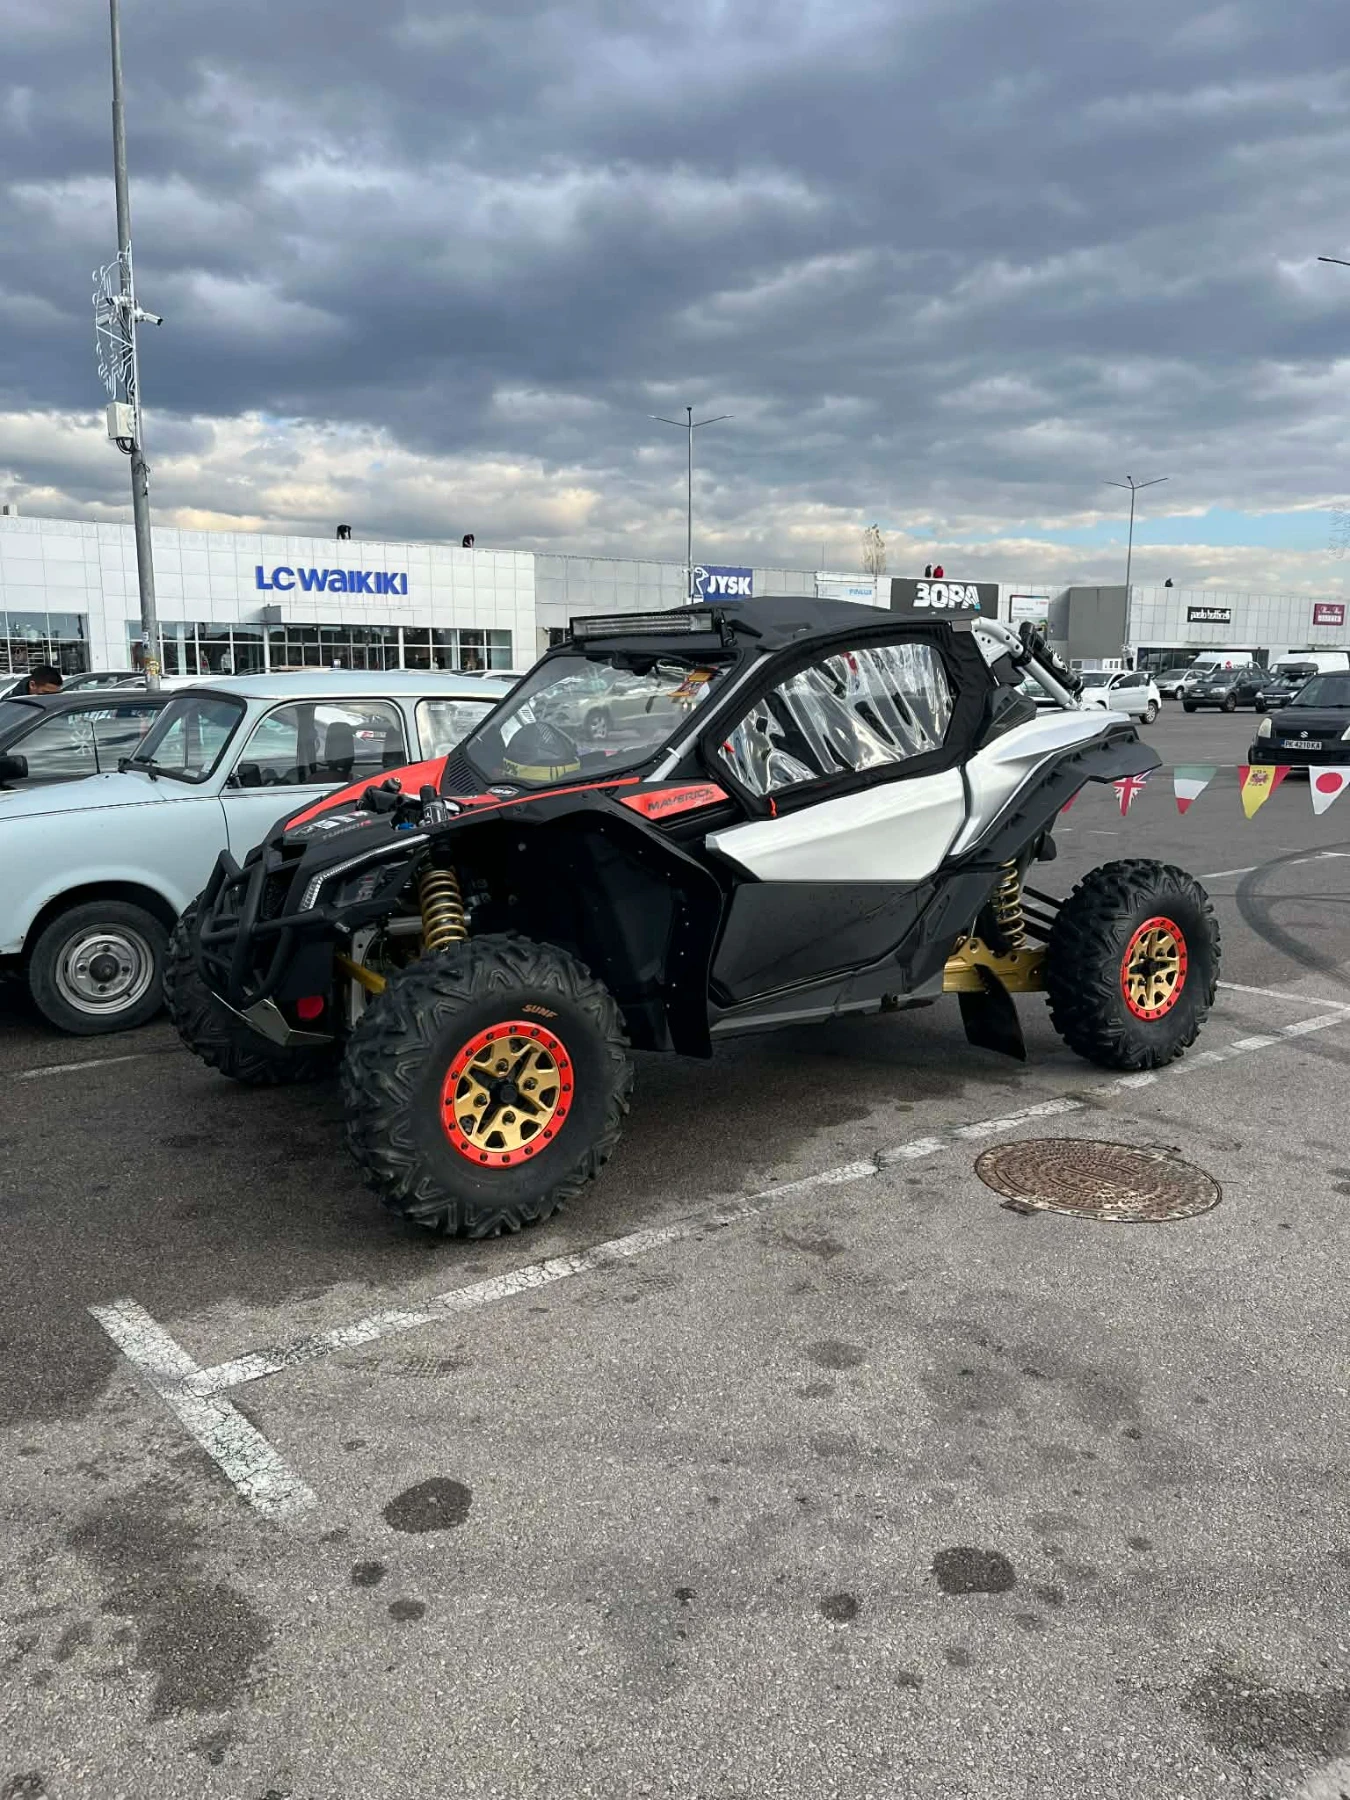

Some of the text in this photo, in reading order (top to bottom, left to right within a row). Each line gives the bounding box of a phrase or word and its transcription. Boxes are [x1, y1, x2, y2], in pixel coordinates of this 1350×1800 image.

[255, 565, 295, 591] LC
[707, 575, 752, 595] JYSK
[647, 787, 714, 811] MAVERICK
